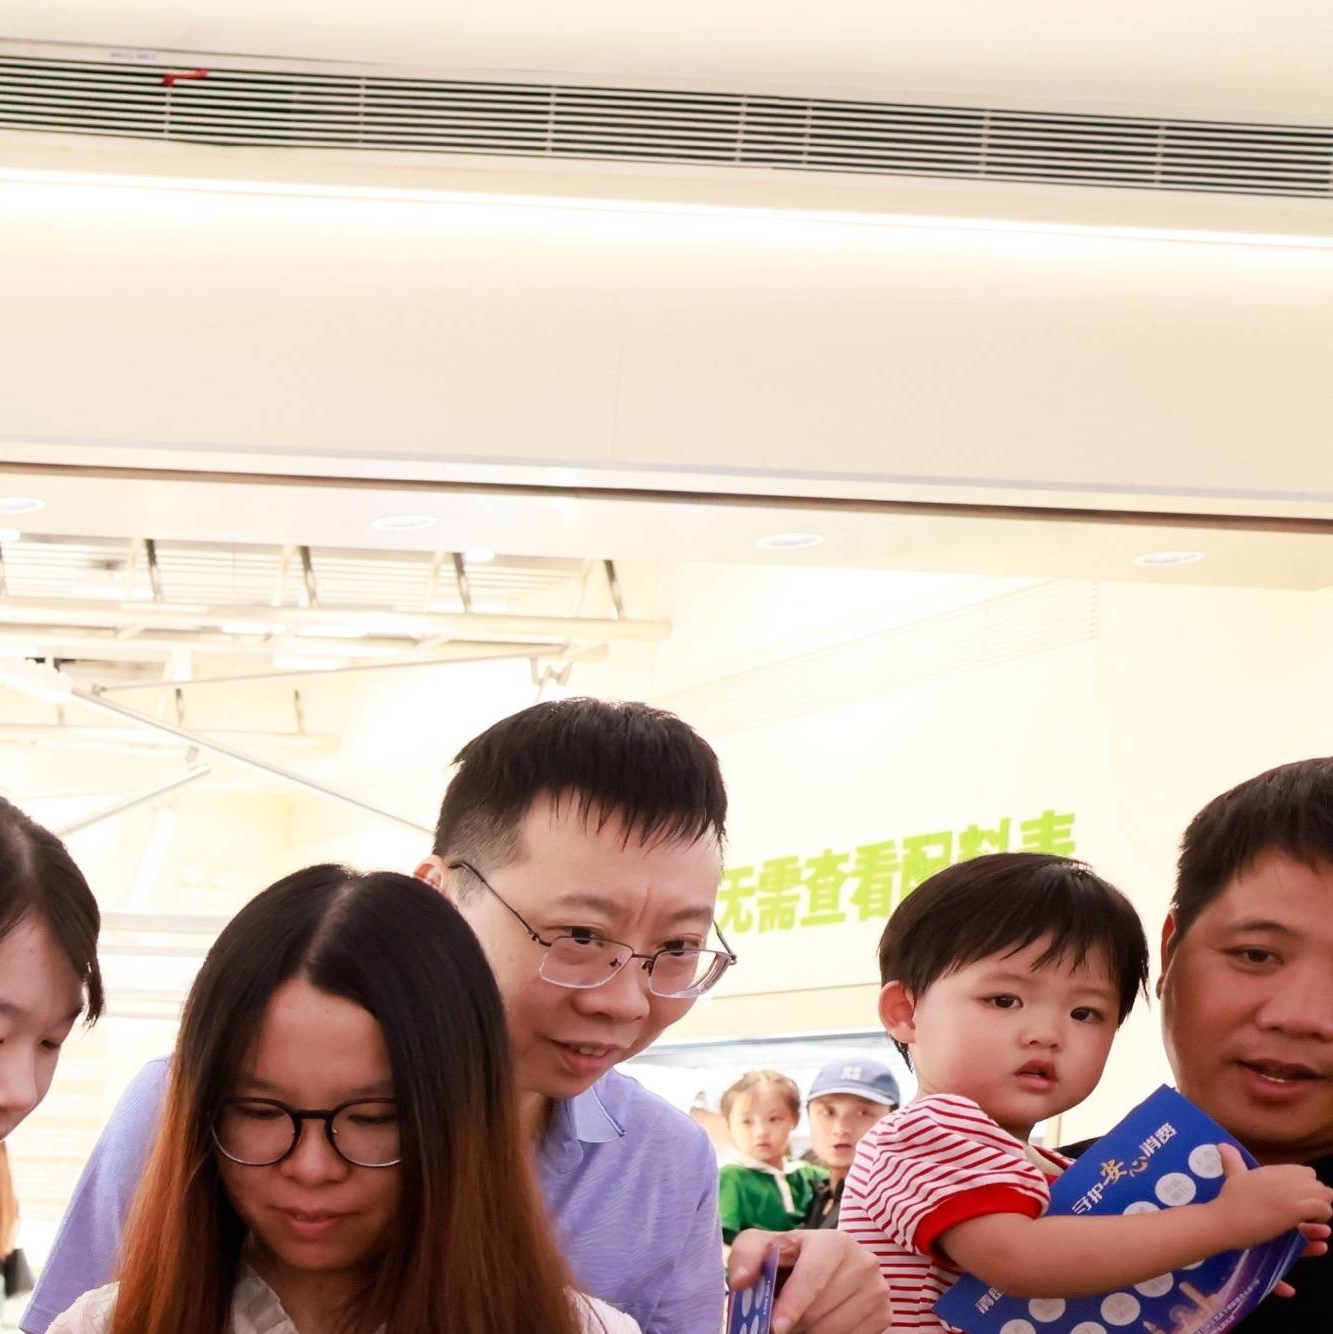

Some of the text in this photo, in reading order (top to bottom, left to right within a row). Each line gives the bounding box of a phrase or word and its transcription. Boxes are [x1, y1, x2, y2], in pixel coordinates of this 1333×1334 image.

[1071, 1121, 1179, 1216] 守护安心消费
